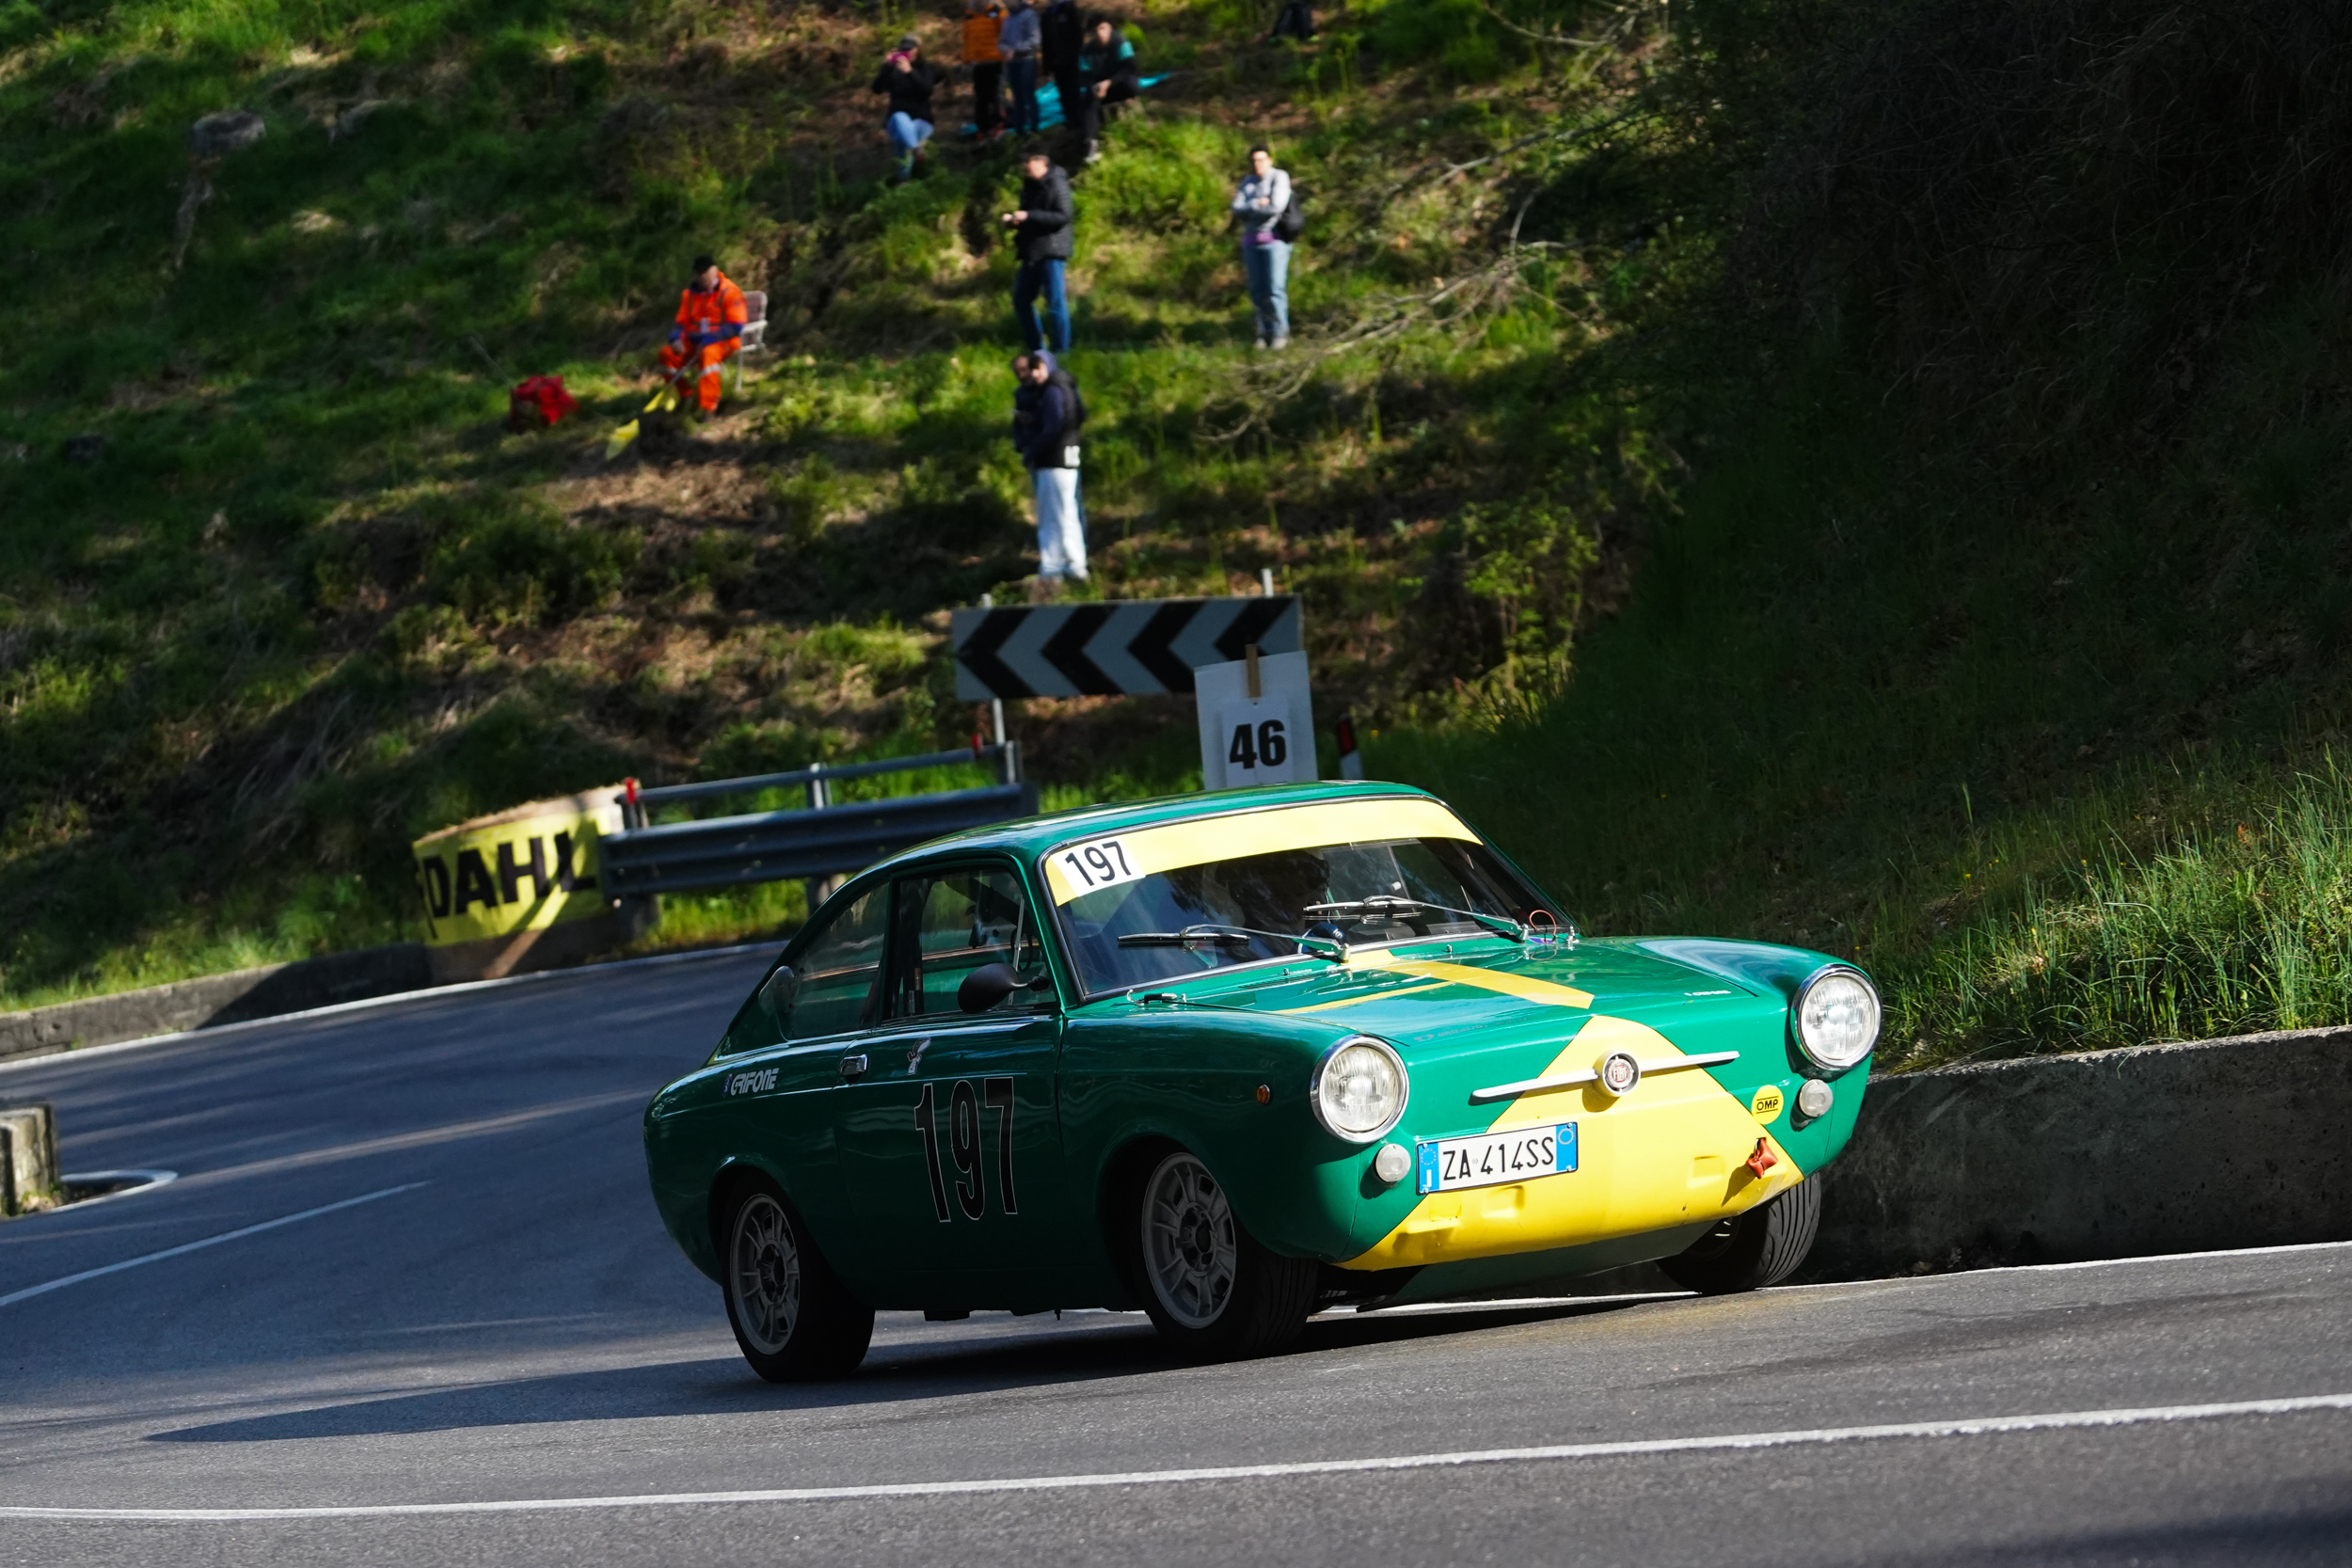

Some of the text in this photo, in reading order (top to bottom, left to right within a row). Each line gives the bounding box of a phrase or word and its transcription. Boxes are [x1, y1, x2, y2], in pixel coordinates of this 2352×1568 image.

[1229, 719, 1287, 769] 46
[422, 830, 597, 939] DAHL
[1064, 840, 1132, 886] 197
[1756, 1099, 1779, 1111] OMP
[914, 1076, 1018, 1222] 197
